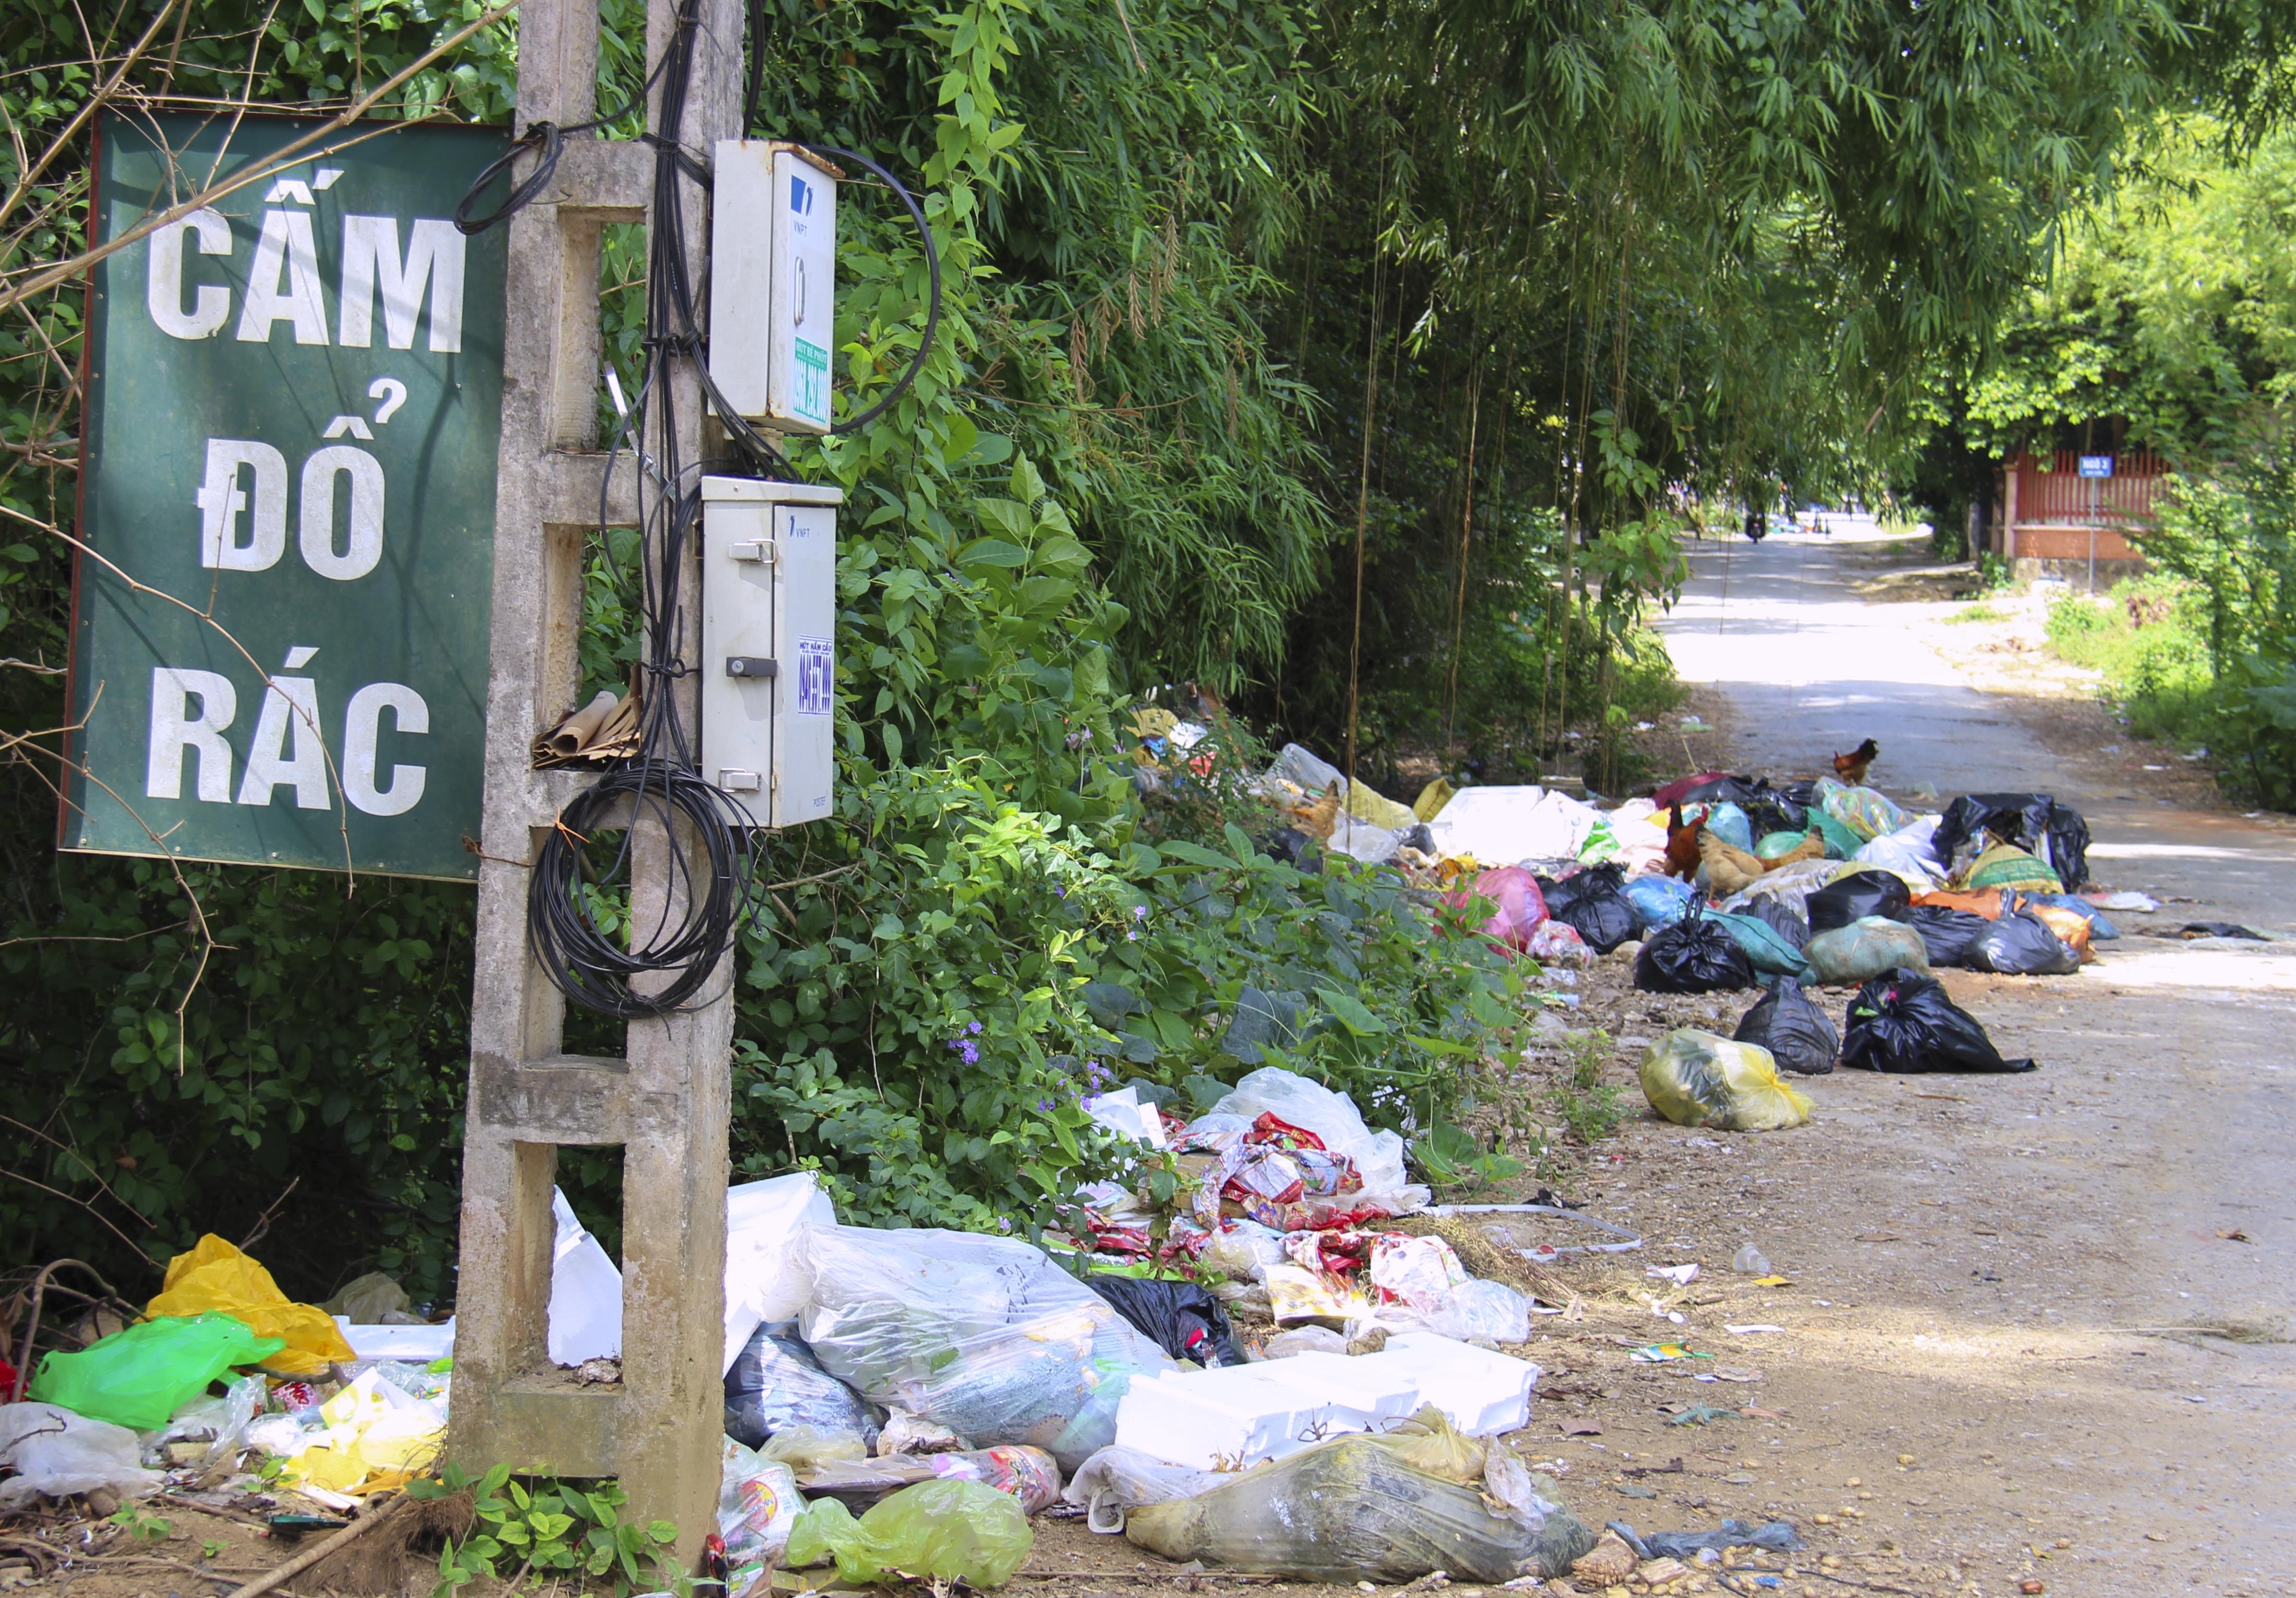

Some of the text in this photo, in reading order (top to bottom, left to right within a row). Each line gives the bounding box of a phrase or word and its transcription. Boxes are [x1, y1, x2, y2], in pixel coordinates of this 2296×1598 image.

[147, 170, 467, 353] CẤM
[794, 220, 807, 237] VNPT
[196, 378, 407, 581] ĐỔ
[796, 528, 810, 538] VNPT
[146, 647, 429, 816] RÁC
